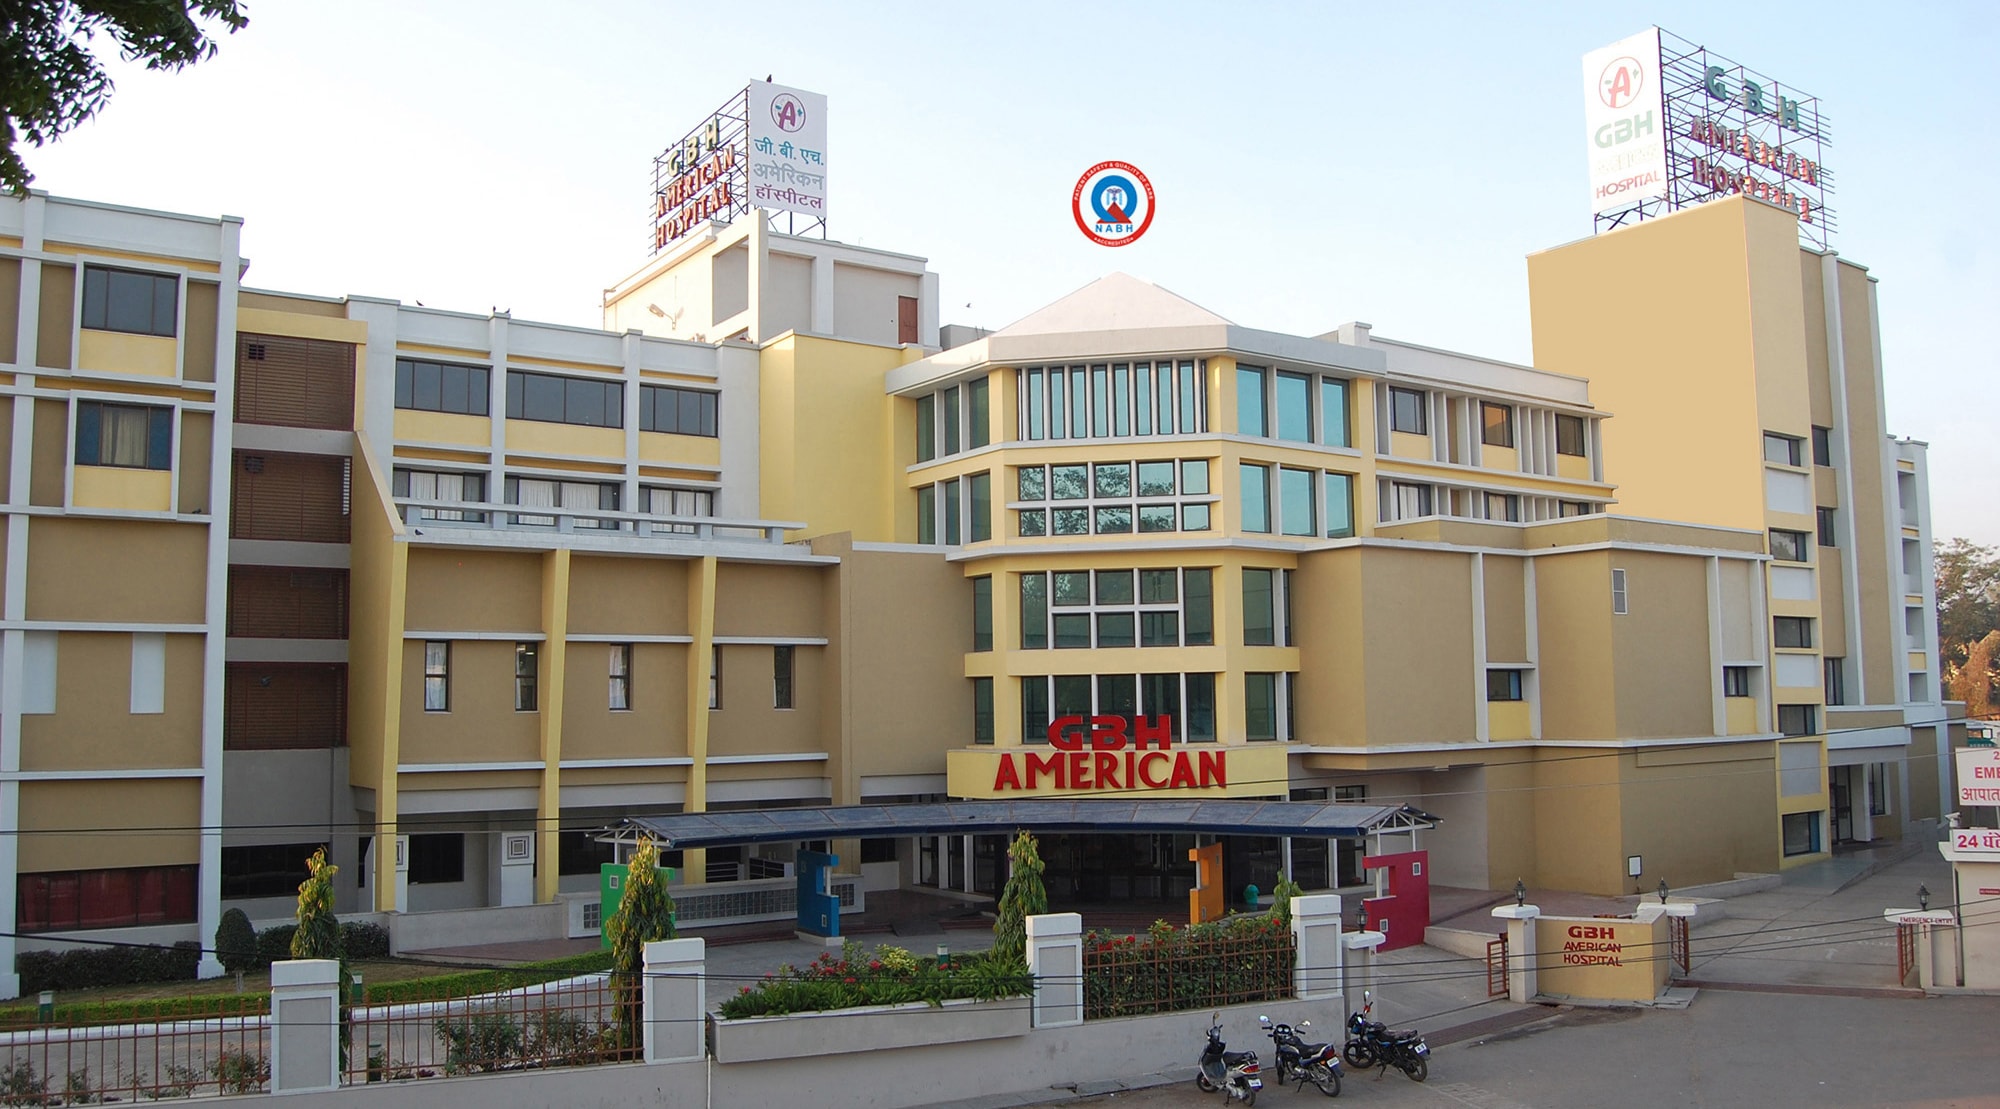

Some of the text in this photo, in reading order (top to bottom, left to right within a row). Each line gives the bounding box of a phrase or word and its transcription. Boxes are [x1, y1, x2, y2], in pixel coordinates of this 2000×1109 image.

[1704, 65, 1799, 133] GBH
[667, 118, 720, 177] GBH
[1594, 110, 1653, 149] GBH
[1691, 115, 1817, 186] AMERICAN
[656, 144, 735, 219] AMERICAN
[753, 160, 824, 190] अमेरिकन
[1596, 170, 1661, 199] HOSPITAL
[754, 183, 823, 209] हॉस्पीटल
[656, 182, 732, 249] HOSPITAL
[1047, 714, 1171, 751] GBH
[993, 751, 1227, 791] AMERICAN
[1957, 834, 1979, 848] 24
[1564, 941, 1621, 953] AMERICAN
[1568, 925, 1614, 939] GBH
[1563, 953, 1623, 967] HOSPITAL
